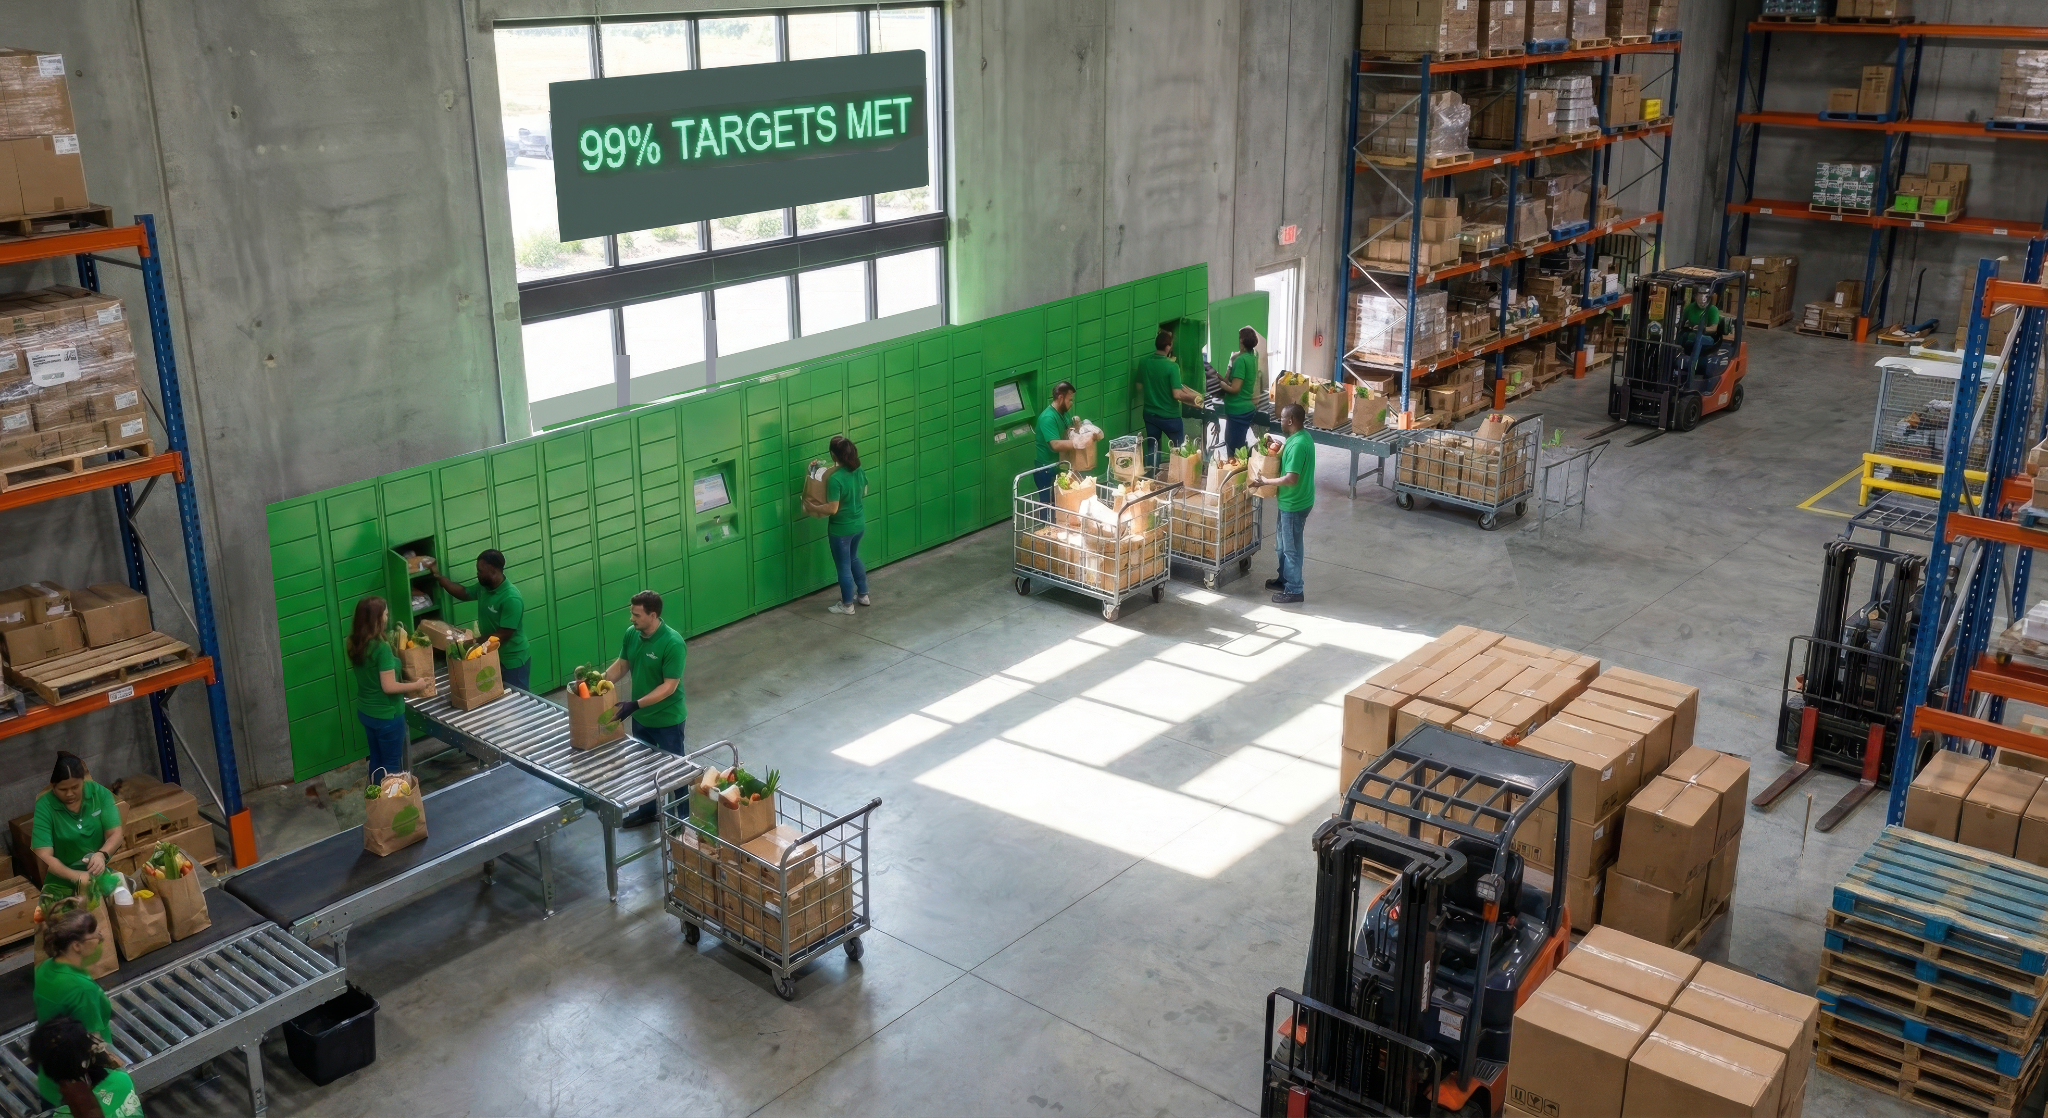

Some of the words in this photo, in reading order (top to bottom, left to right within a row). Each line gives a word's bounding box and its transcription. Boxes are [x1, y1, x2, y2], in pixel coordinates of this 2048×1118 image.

[580, 122, 661, 171] 99%
[672, 105, 837, 160] TARGETS
[847, 96, 913, 140] MET
